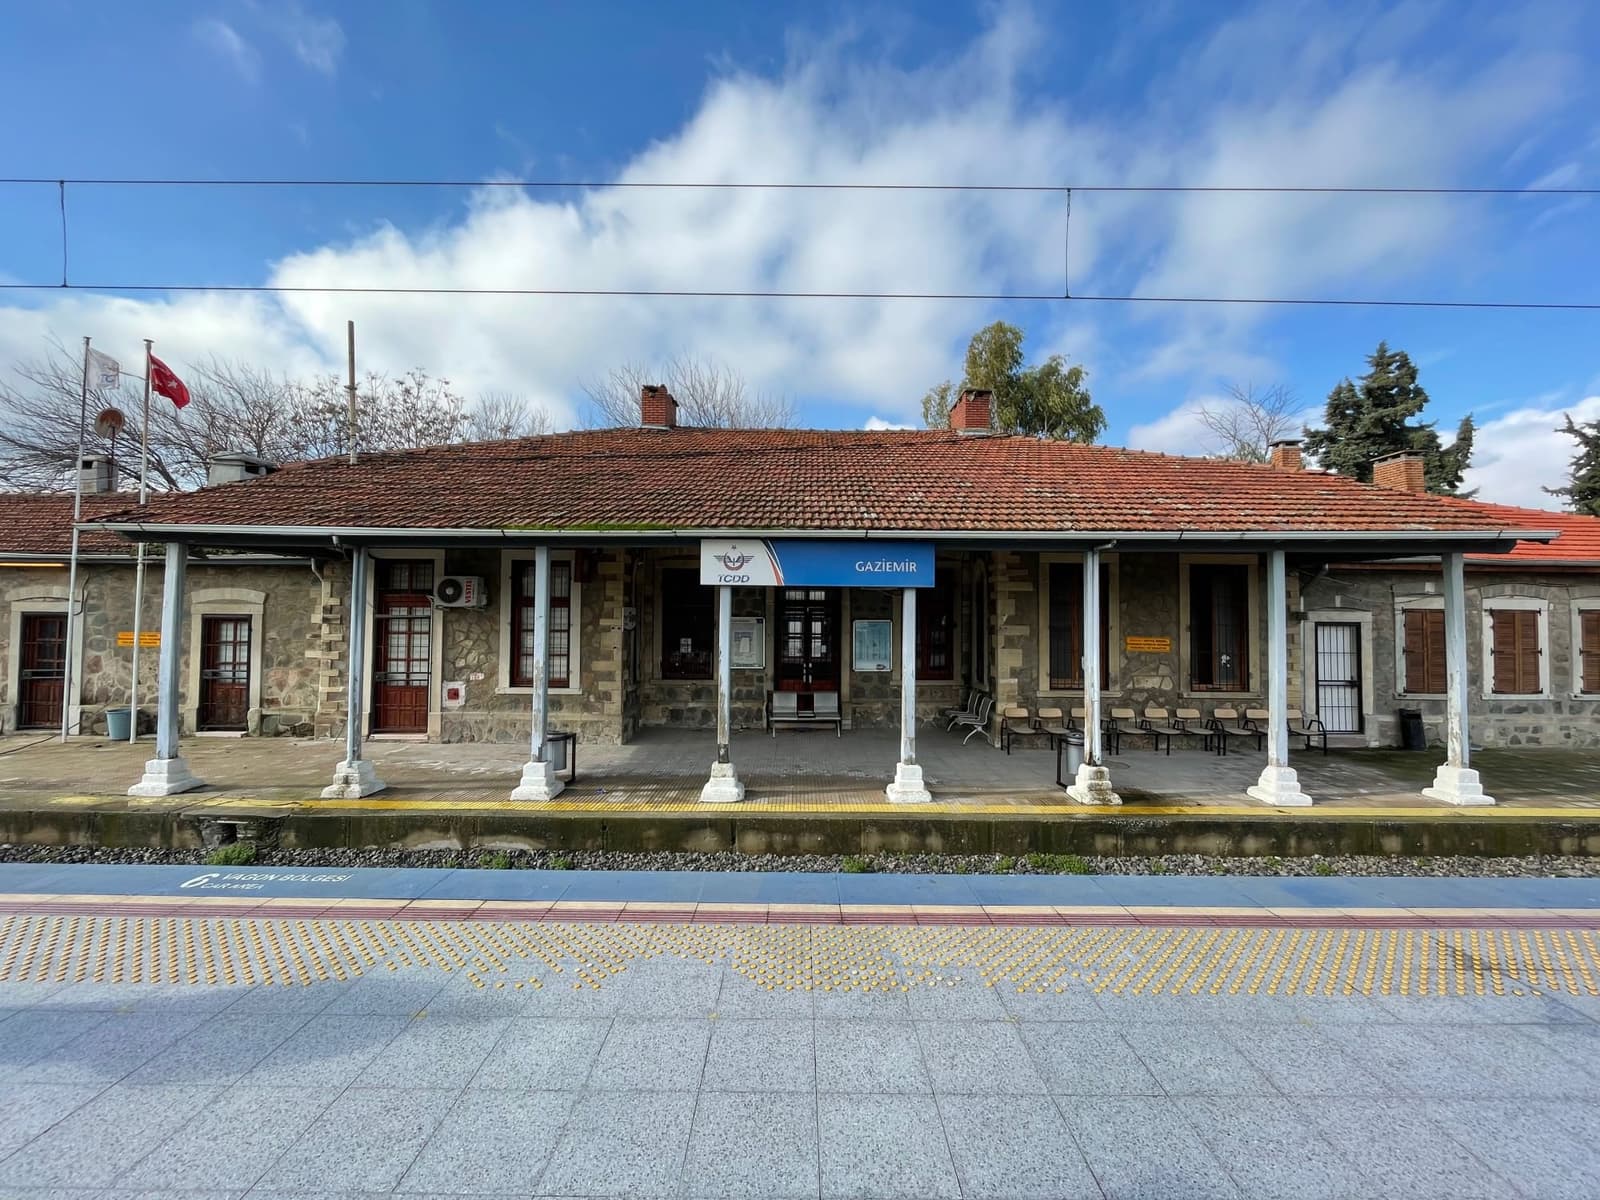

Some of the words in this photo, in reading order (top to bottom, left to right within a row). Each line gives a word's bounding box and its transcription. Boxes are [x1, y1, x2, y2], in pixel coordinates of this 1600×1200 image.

[855, 558, 917, 572] GAZİEMİR
[718, 574, 750, 583] TCDD
[222, 873, 280, 881] VAGON
